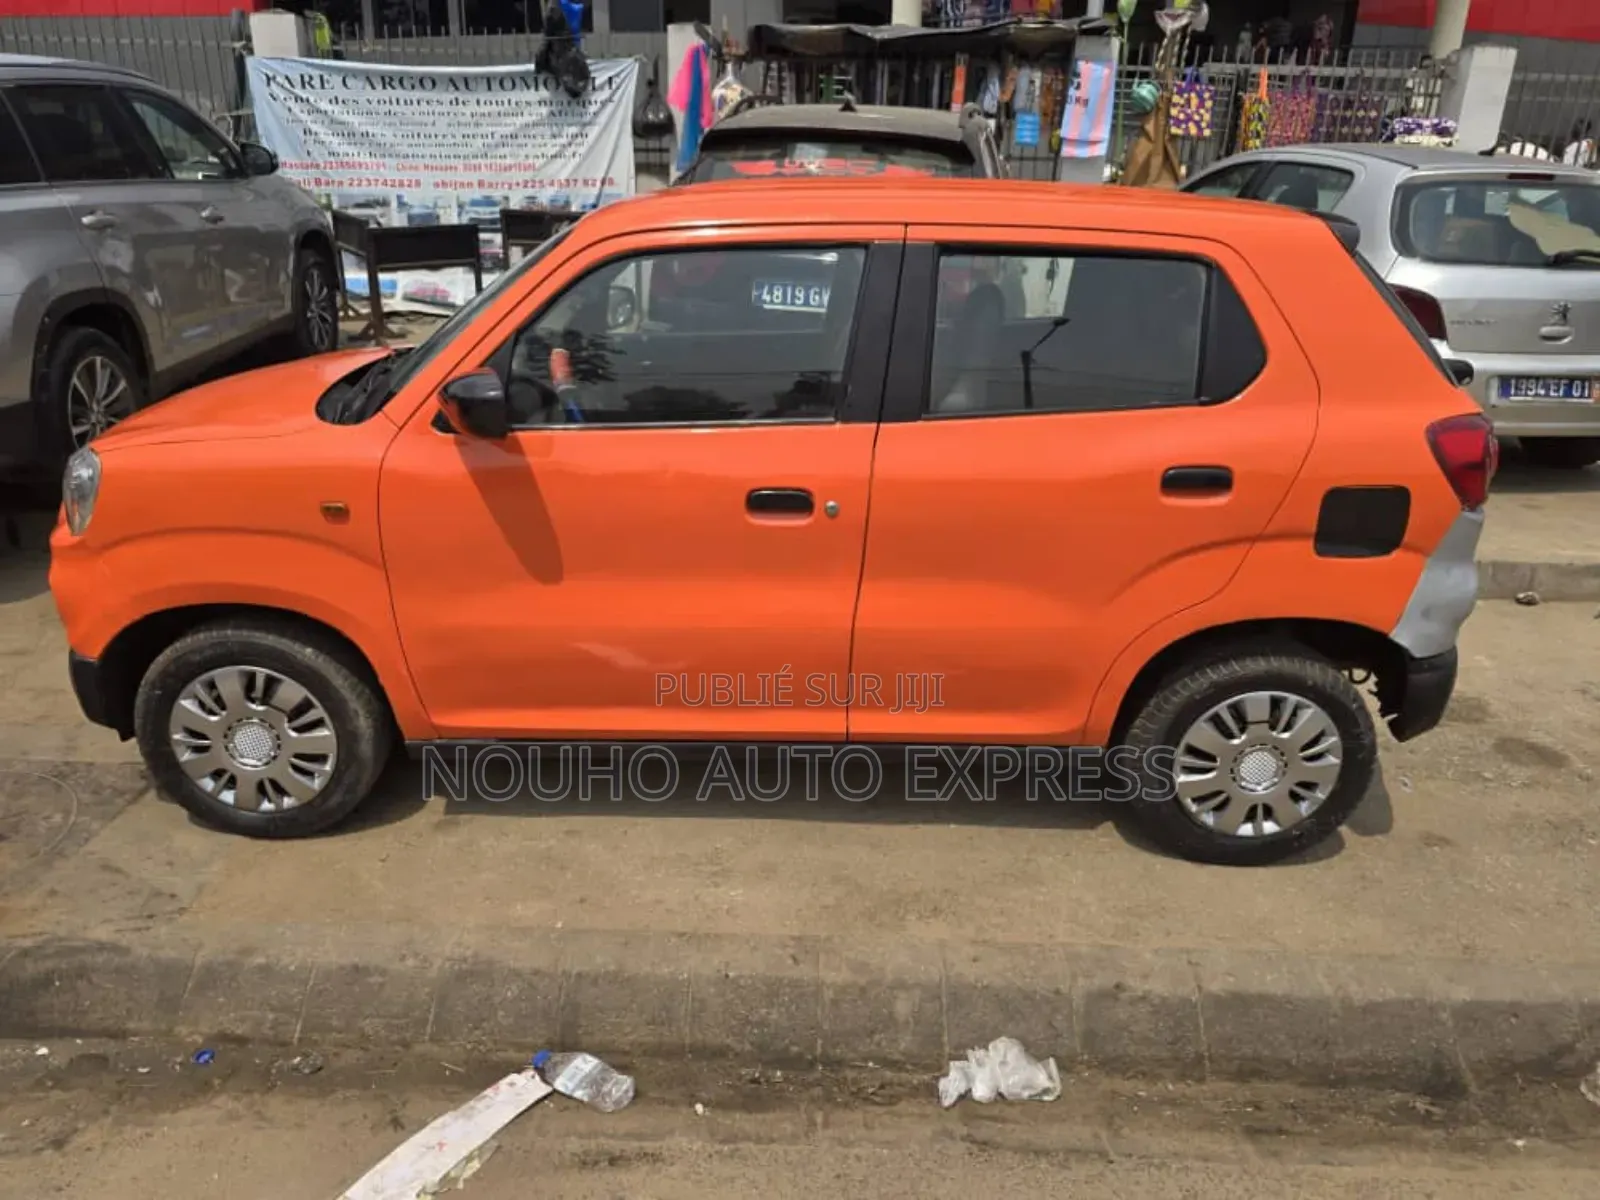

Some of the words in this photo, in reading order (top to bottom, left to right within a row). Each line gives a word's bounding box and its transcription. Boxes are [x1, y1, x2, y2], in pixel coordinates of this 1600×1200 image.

[341, 75, 438, 92] CARGO
[446, 75, 620, 92] AUTOMOLE
[328, 95, 360, 106] des
[366, 96, 444, 107] voitures
[449, 97, 471, 107] de
[476, 97, 532, 107] toutes
[761, 284, 804, 305] 4819
